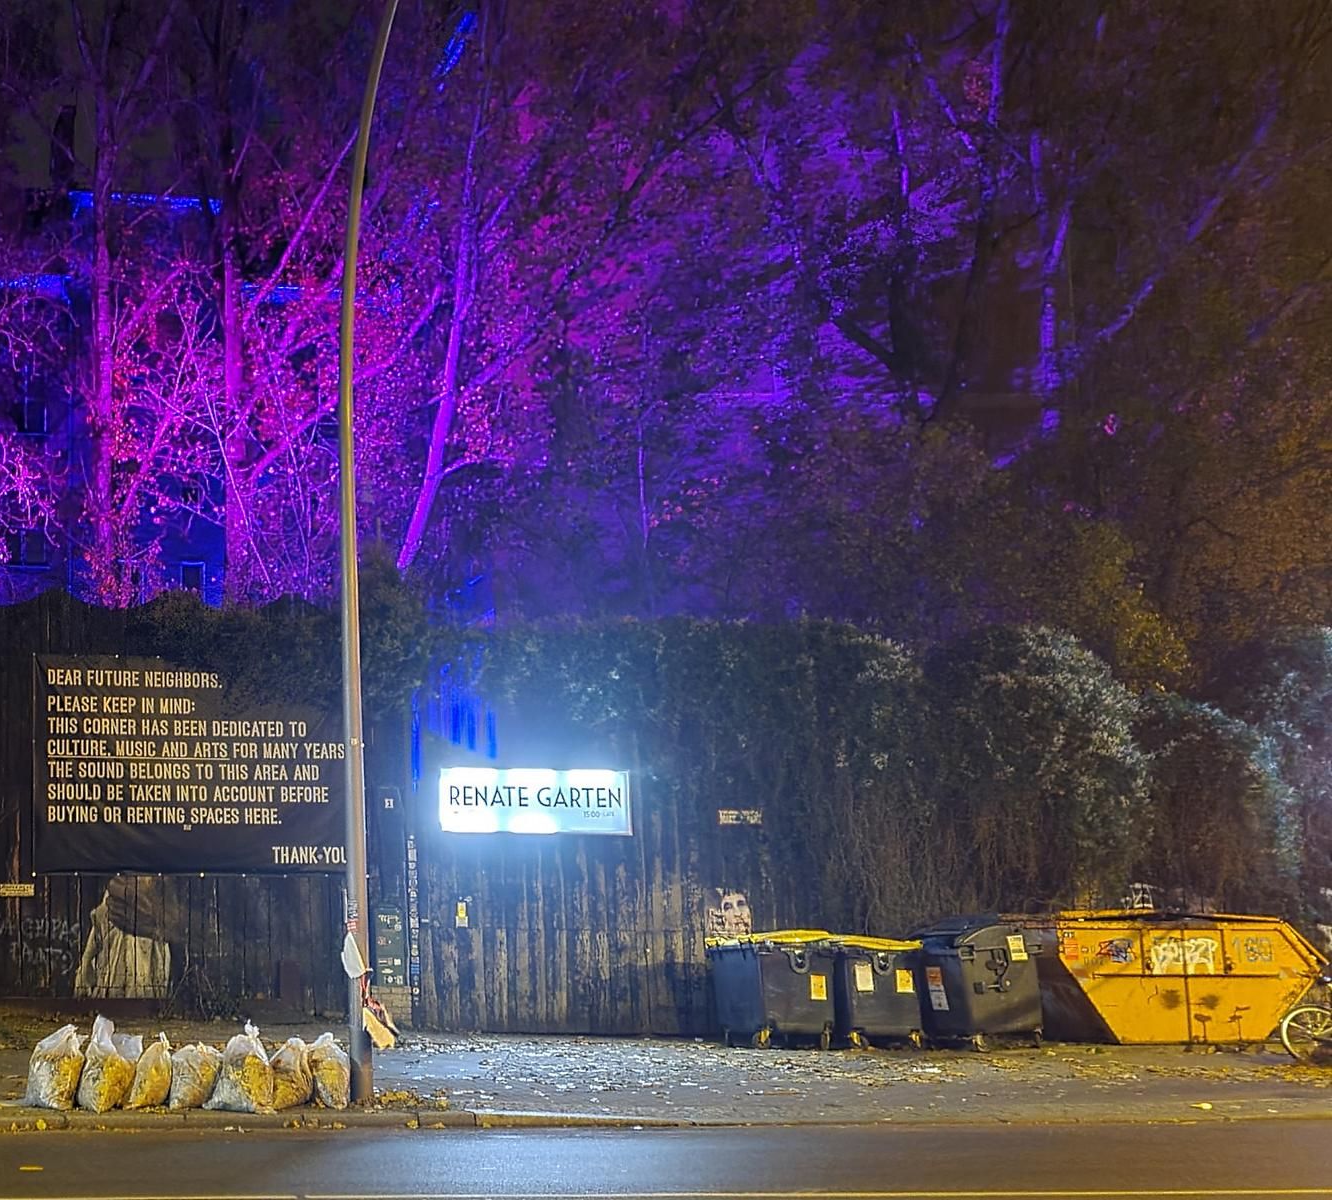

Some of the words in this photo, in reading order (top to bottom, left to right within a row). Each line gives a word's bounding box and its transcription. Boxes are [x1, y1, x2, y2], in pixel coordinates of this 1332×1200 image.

[47, 669, 82, 687] DEAR
[86, 670, 140, 688] FUTURE
[47, 696, 99, 713] PLEASE
[102, 697, 137, 714] KEEP
[141, 698, 155, 714] IN
[159, 698, 197, 715] MIND:
[47, 717, 79, 736] THIS
[82, 719, 137, 736] CORNER
[141, 720, 169, 737] HAS
[173, 720, 207, 738] BEEN
[211, 721, 284, 738] DEDICATED
[288, 722, 308, 738] TO
[115, 741, 157, 758] MUSIC
[161, 742, 188, 759] AND
[193, 743, 229, 759] ARTS
[232, 743, 259, 760] FOR
[262, 743, 298, 760] MANY
[301, 744, 346, 760] YEARS
[47, 761, 74, 779] THE
[78, 762, 125, 780] SOUND
[129, 763, 191, 781] BELONGS
[195, 764, 214, 781] TO
[218, 764, 250, 782] THIS
[253, 765, 288, 782] AREA
[293, 765, 321, 782] AND
[47, 784, 102, 801] SHOULD
[106, 785, 125, 802] BE
[128, 785, 172, 803] TAKEN
[175, 785, 209, 803] INTO
[212, 786, 276, 803] ACCOUNT
[280, 787, 330, 804] BEFORE
[449, 785, 529, 808] RENATE
[536, 786, 622, 809] GARTEN
[47, 806, 99, 824] BUYING
[103, 807, 122, 824] OR
[126, 807, 187, 825] RENTING
[190, 808, 240, 825] SPACES
[244, 809, 283, 826] HERE.
[271, 846, 318, 866] THANK
